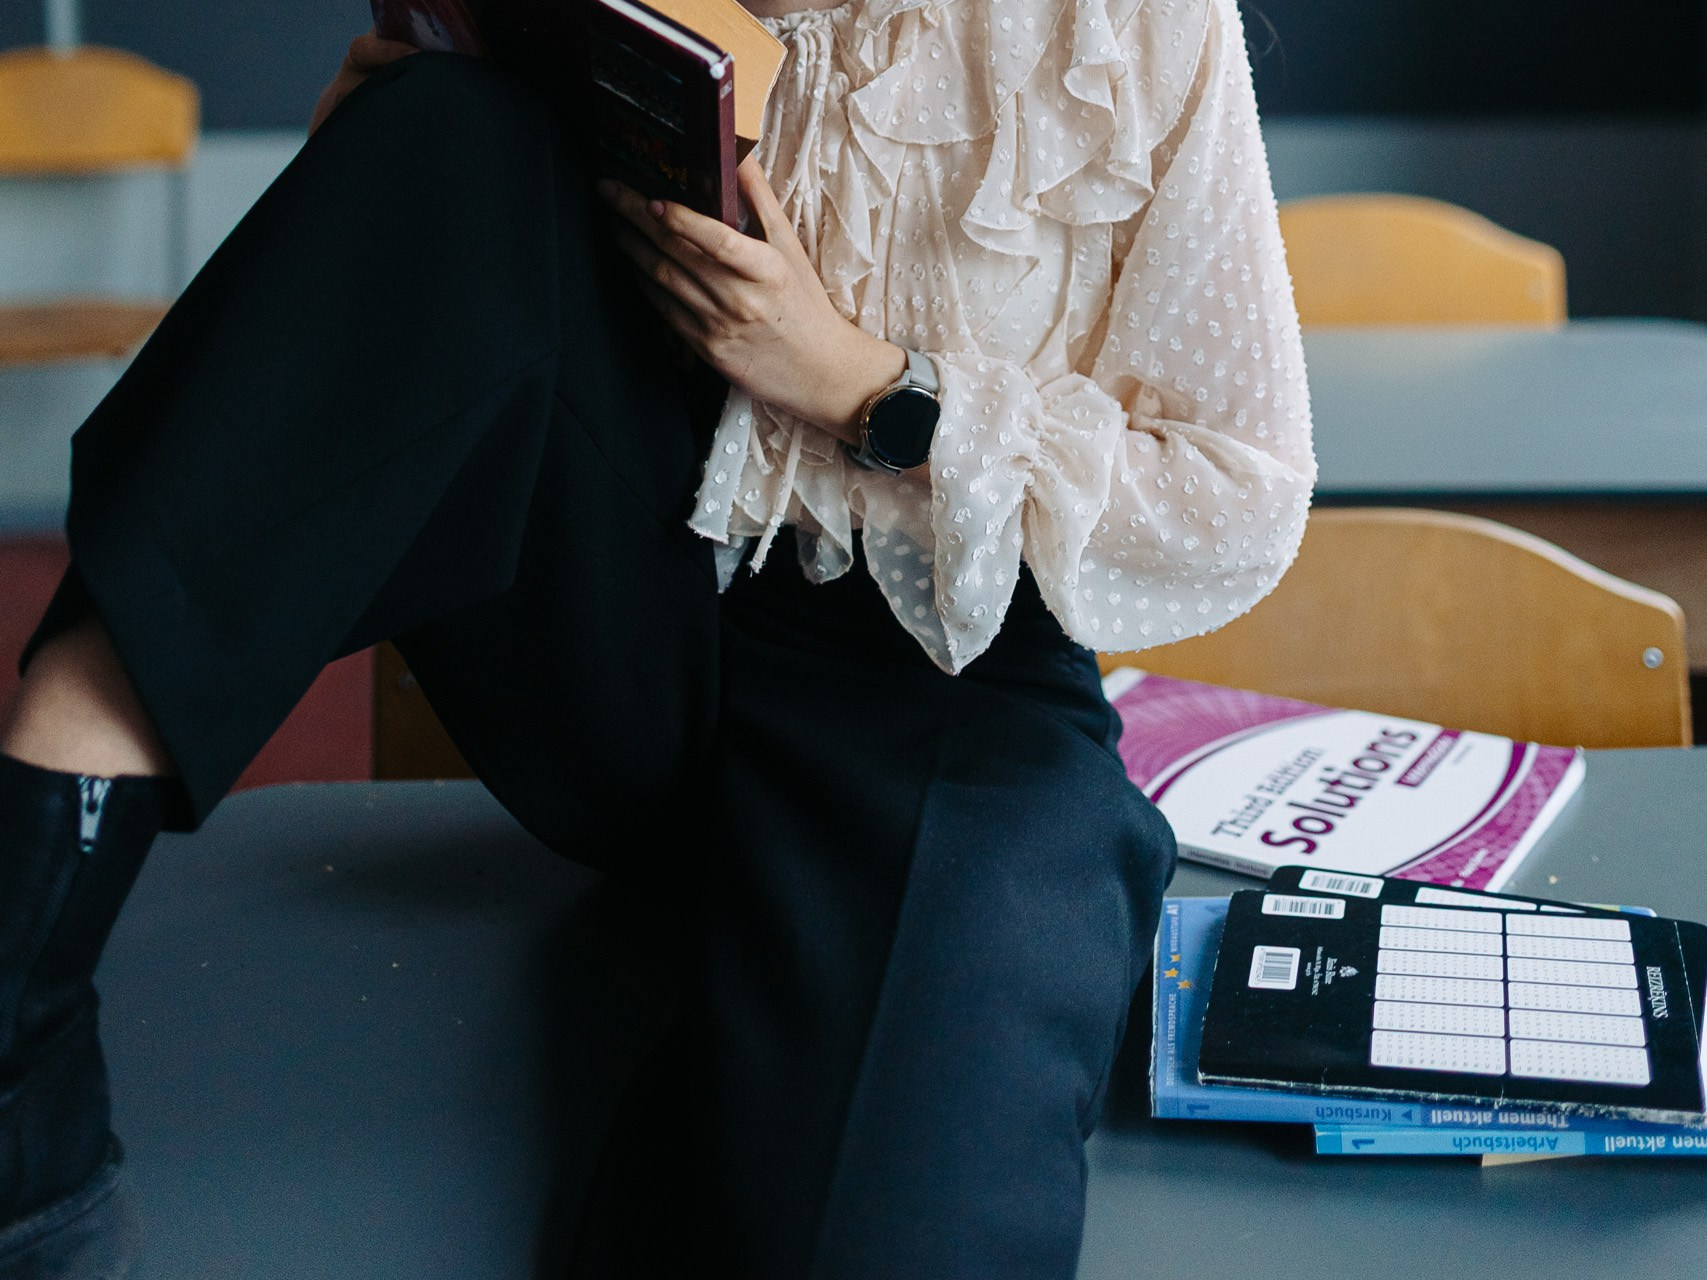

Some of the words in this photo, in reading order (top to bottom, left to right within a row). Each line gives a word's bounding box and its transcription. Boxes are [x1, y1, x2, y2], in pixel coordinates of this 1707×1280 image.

[1211, 793, 1273, 837] Third
[1257, 747, 1325, 795] Edition
[1260, 729, 1418, 854] Solutions
[1166, 904, 1179, 915] A1
[1646, 966, 1668, 1018] REIZRĒĶINS
[1187, 1104, 1210, 1115] 1
[1315, 1106, 1391, 1120] Kursbuch
[1431, 1109, 1489, 1125] aktuell
[1499, 1111, 1569, 1128] Themen
[1352, 1138, 1375, 1150] 1
[1452, 1136, 1558, 1155] Arbeitsbuch
[1604, 1136, 1665, 1152] aktuell
